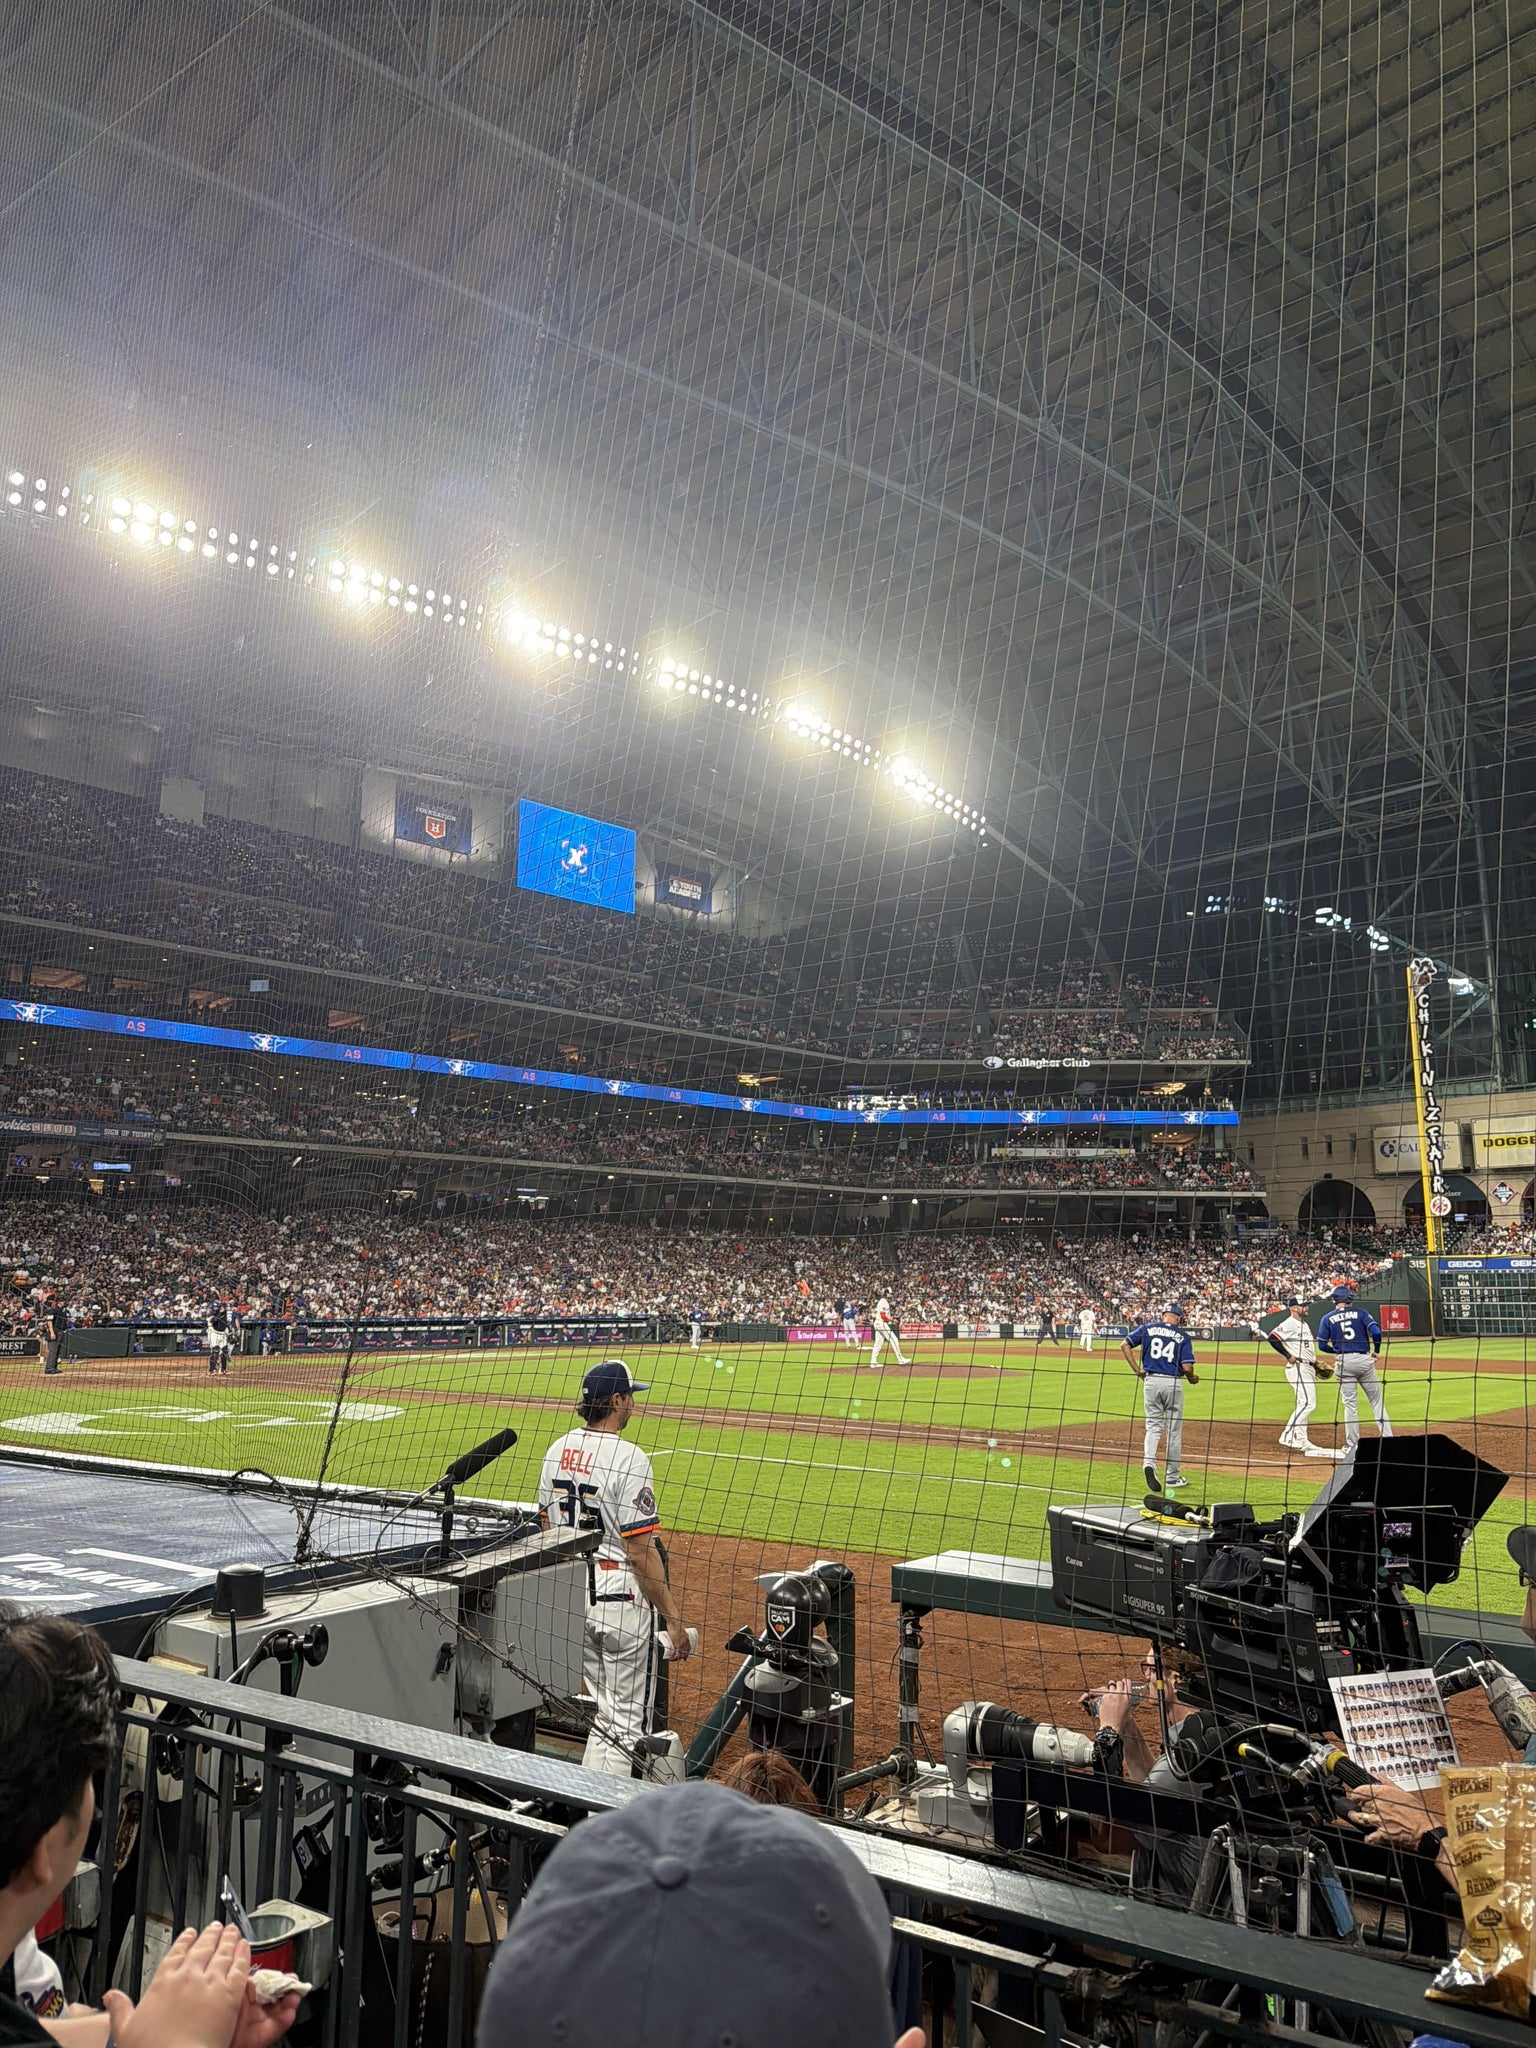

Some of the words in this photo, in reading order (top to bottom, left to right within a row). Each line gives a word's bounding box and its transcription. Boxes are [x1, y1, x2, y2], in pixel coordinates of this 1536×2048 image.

[1007, 1058, 1060, 1069] Gallagher
[1062, 1058, 1090, 1068] Club
[1409, 1260, 1426, 1269] 315
[1340, 1321, 1356, 1340] 5
[1150, 1338, 1175, 1363] 84
[561, 1448, 593, 1475] BELL
[1065, 1556, 1083, 1568] Canon
[13, 1561, 180, 1594] DAIKIN
[1122, 1593, 1156, 1612] DIGISUPER
[1156, 1604, 1166, 1616] 95
[771, 1614, 790, 1624] CAM
